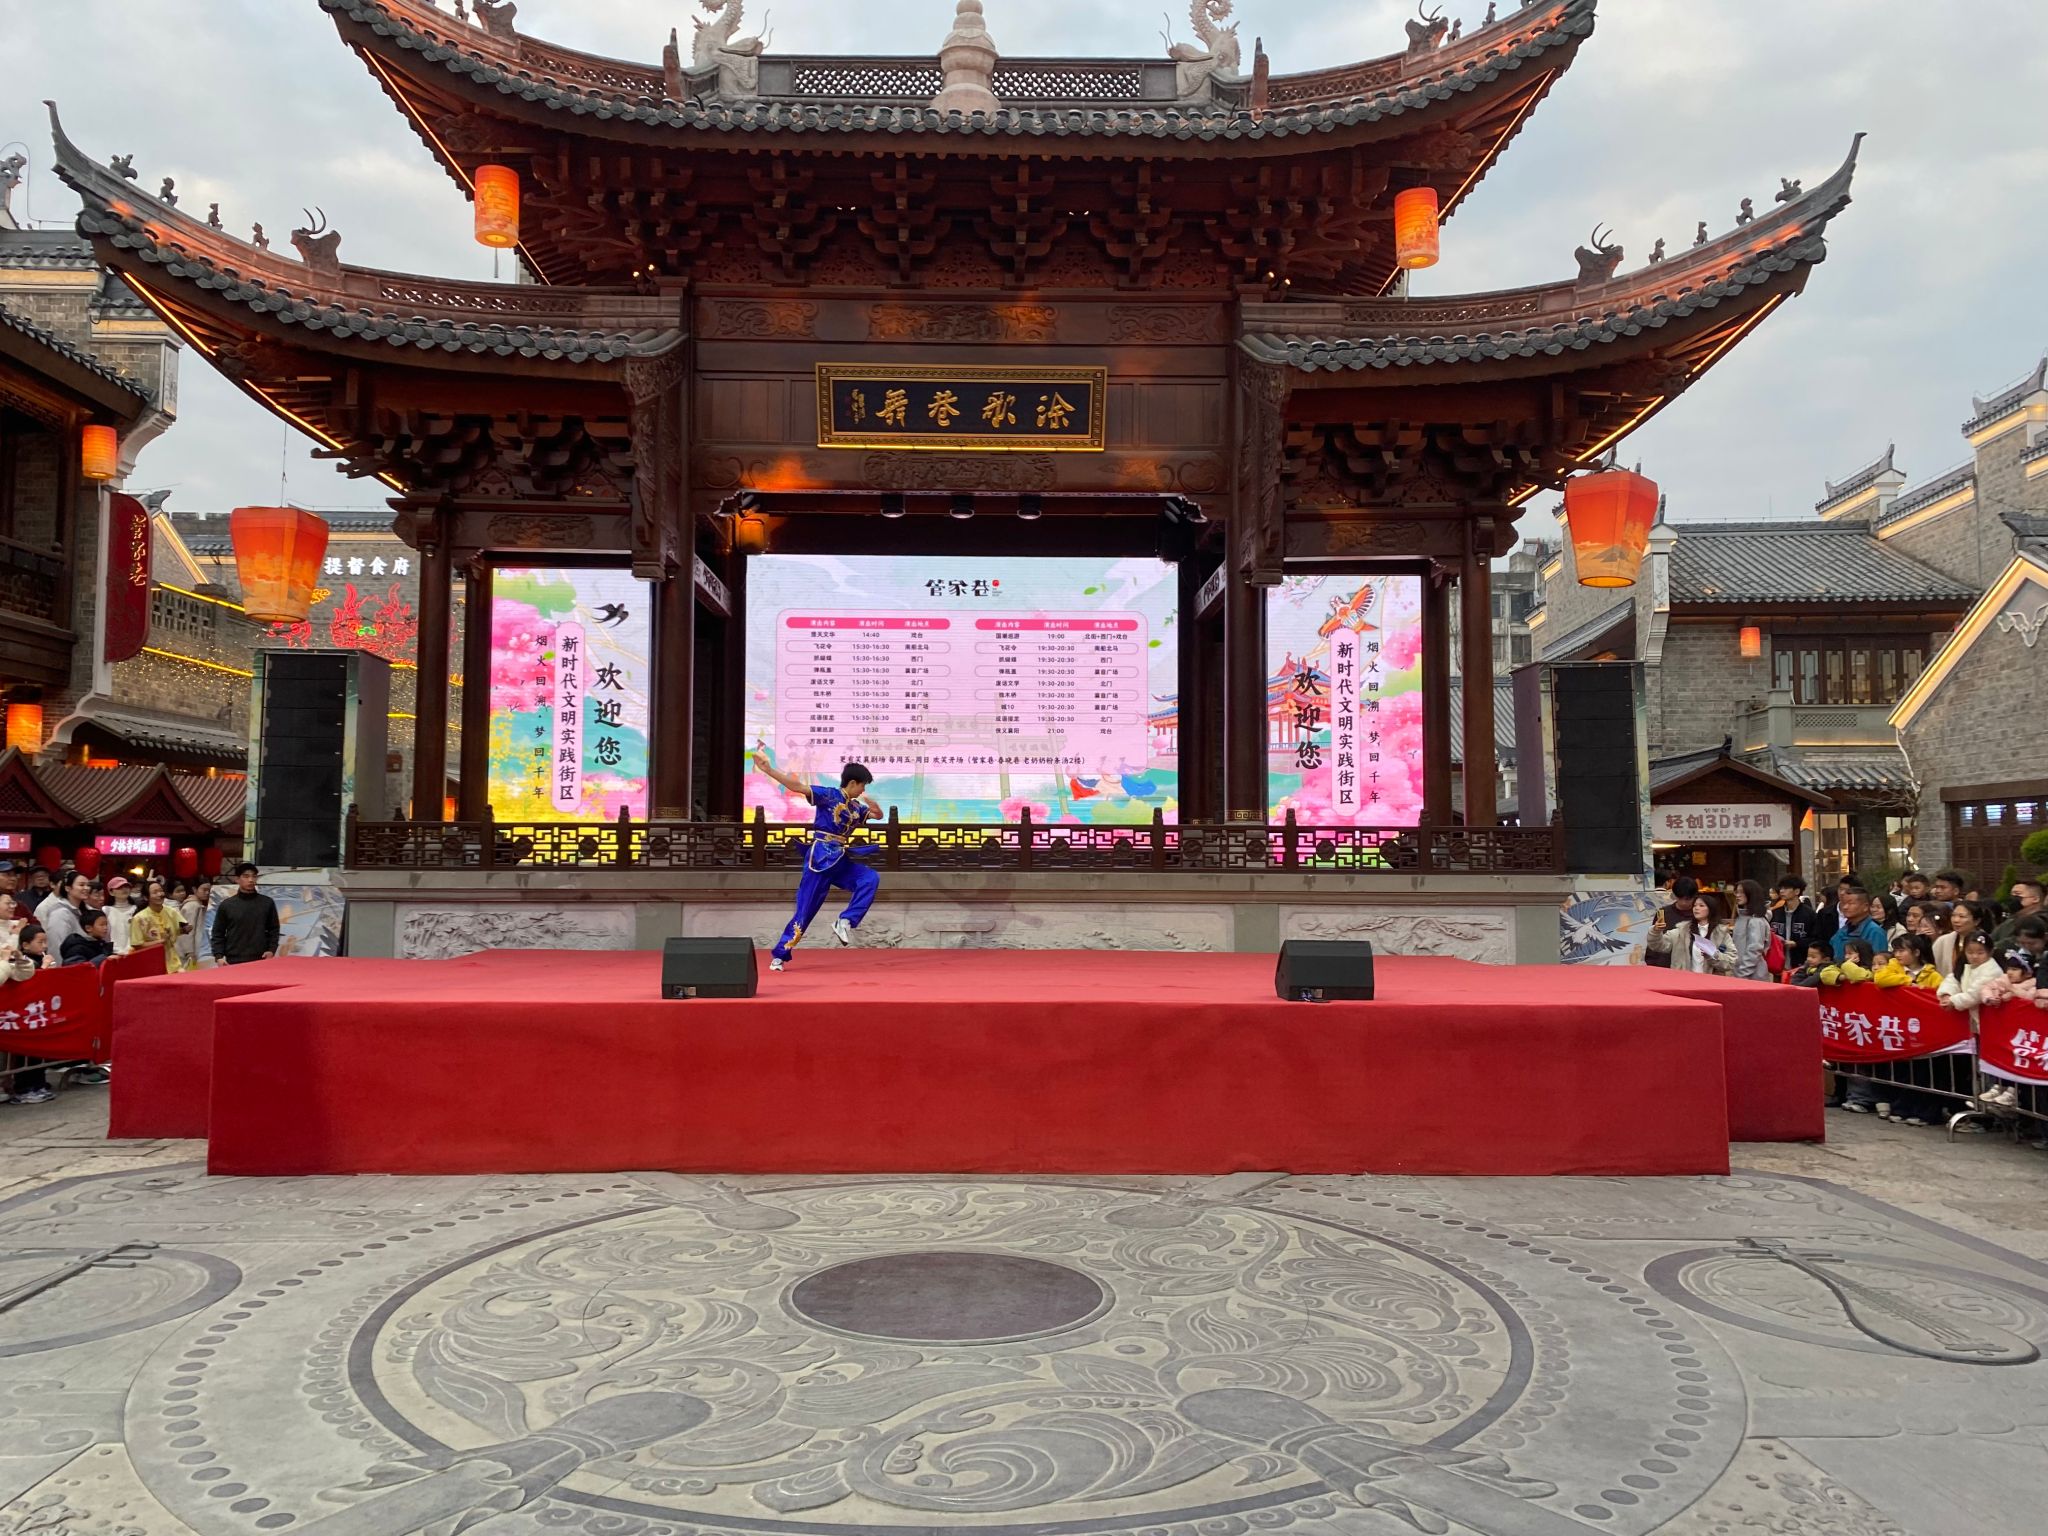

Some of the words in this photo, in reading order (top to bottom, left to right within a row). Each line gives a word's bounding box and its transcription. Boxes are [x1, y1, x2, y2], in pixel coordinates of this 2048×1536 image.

[324, 556, 410, 576] 提督食府
[924, 579, 989, 597] 管家巷
[558, 635, 579, 801] 新时代文明实践街区
[593, 662, 625, 766] 欢迎您
[1294, 666, 1324, 770] 欢迎您
[1337, 642, 1355, 805] 新时代文明实践街区
[1665, 814, 1771, 829] 轻创3D打印
[1819, 1004, 1905, 1051] 管家巷
